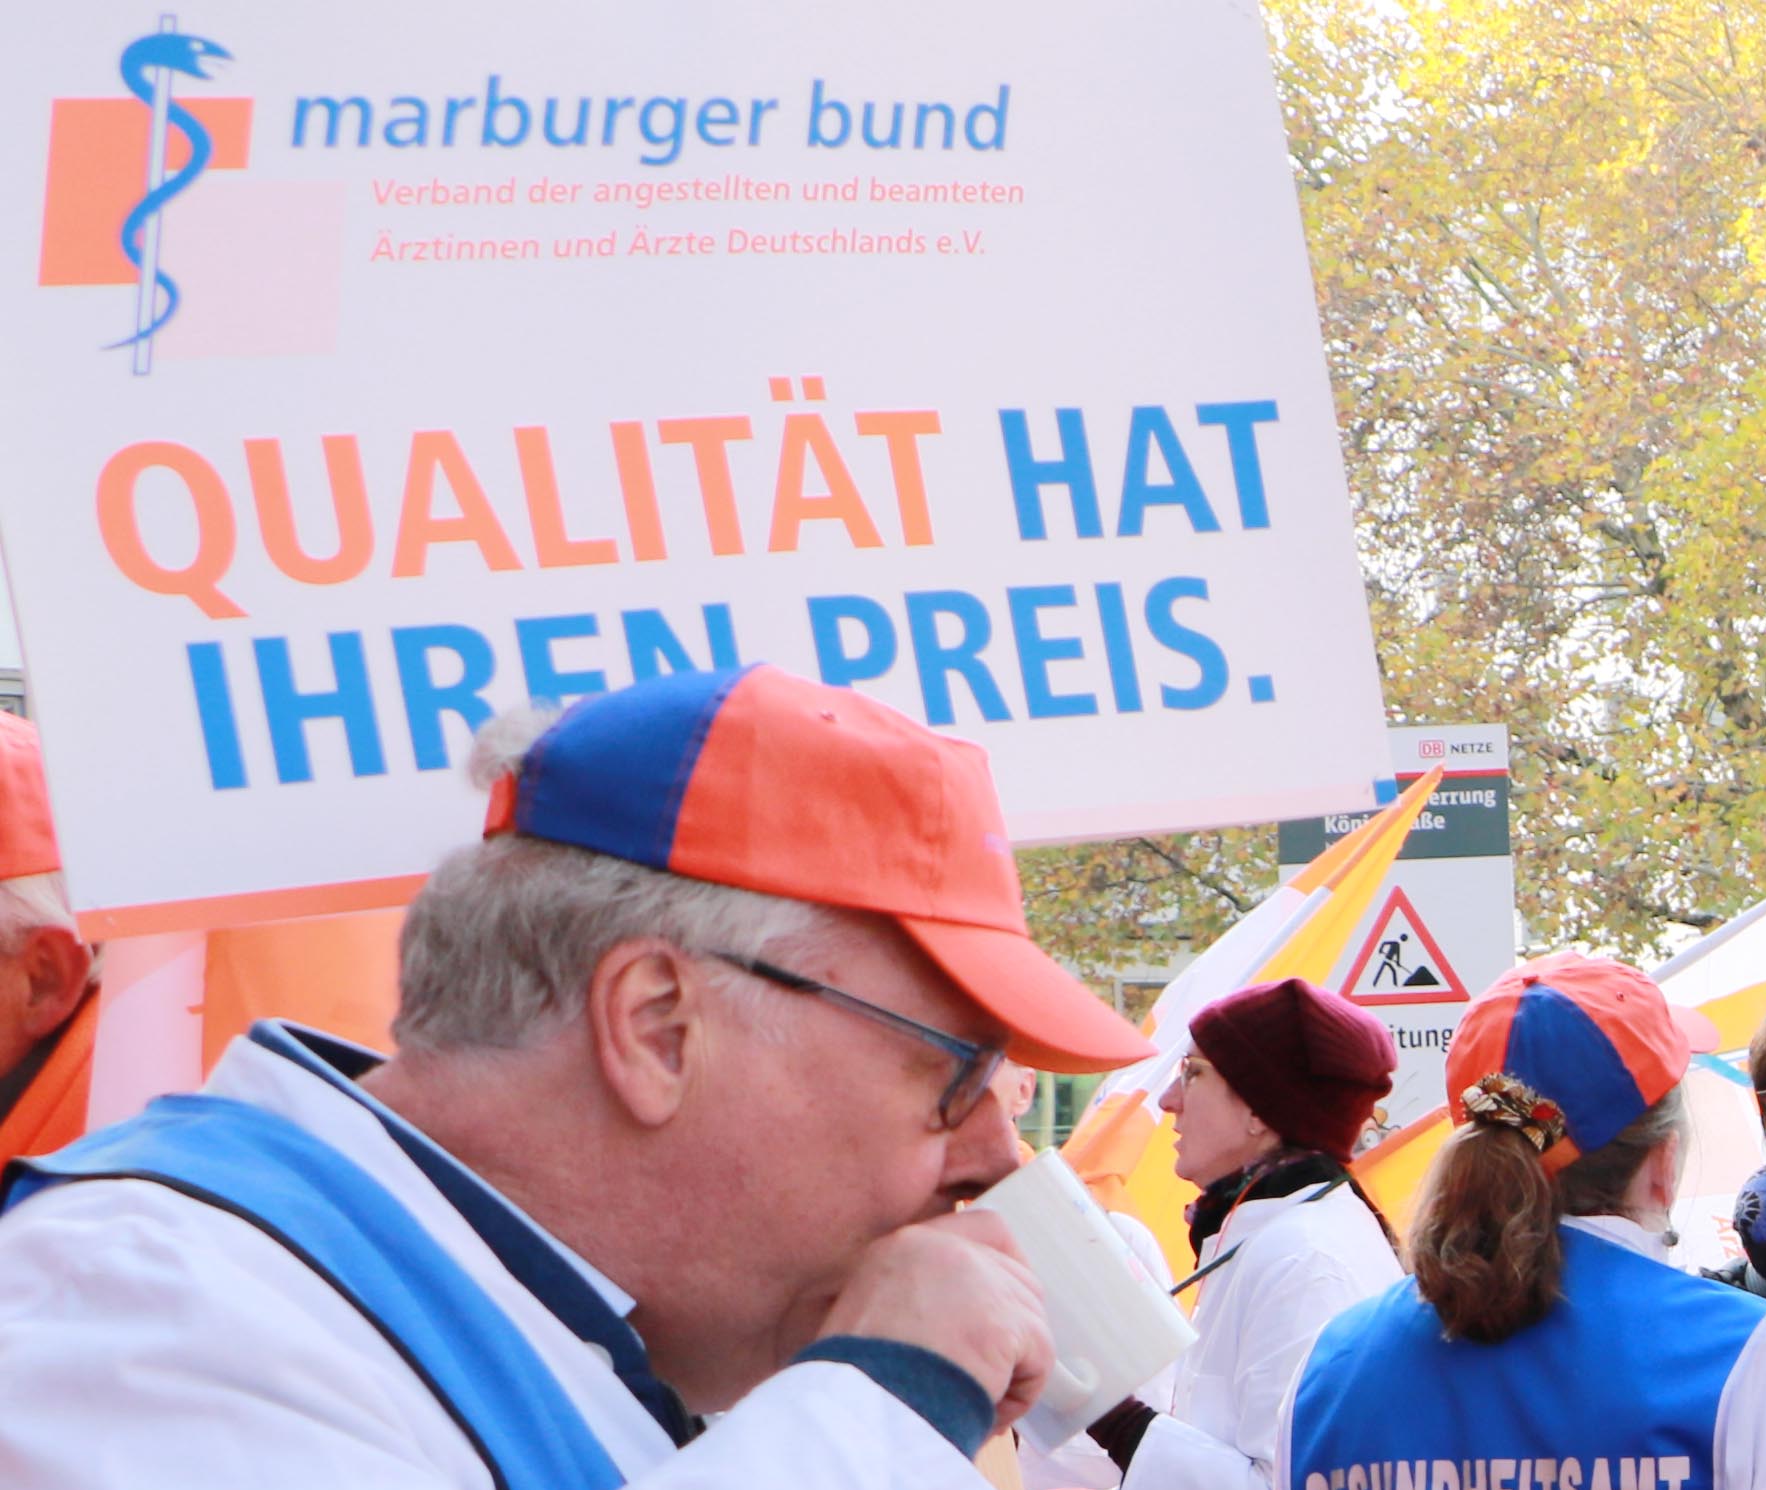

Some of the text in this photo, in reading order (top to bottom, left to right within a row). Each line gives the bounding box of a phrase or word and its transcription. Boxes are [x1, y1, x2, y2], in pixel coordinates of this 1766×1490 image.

[291, 74, 1011, 166] marburger bund
[372, 175, 1025, 209] Verband der angestellten und beamteten
[370, 224, 987, 263] Ärztinnen und Ärzte Deutschlands e.V.
[96, 375, 1280, 620] QUALITÄT HAT
[807, 576, 1277, 727] PREIS.
[1422, 741, 1493, 756] DB NETZE
[1426, 789, 1497, 808] errung
[1389, 1024, 1453, 1053] itung
